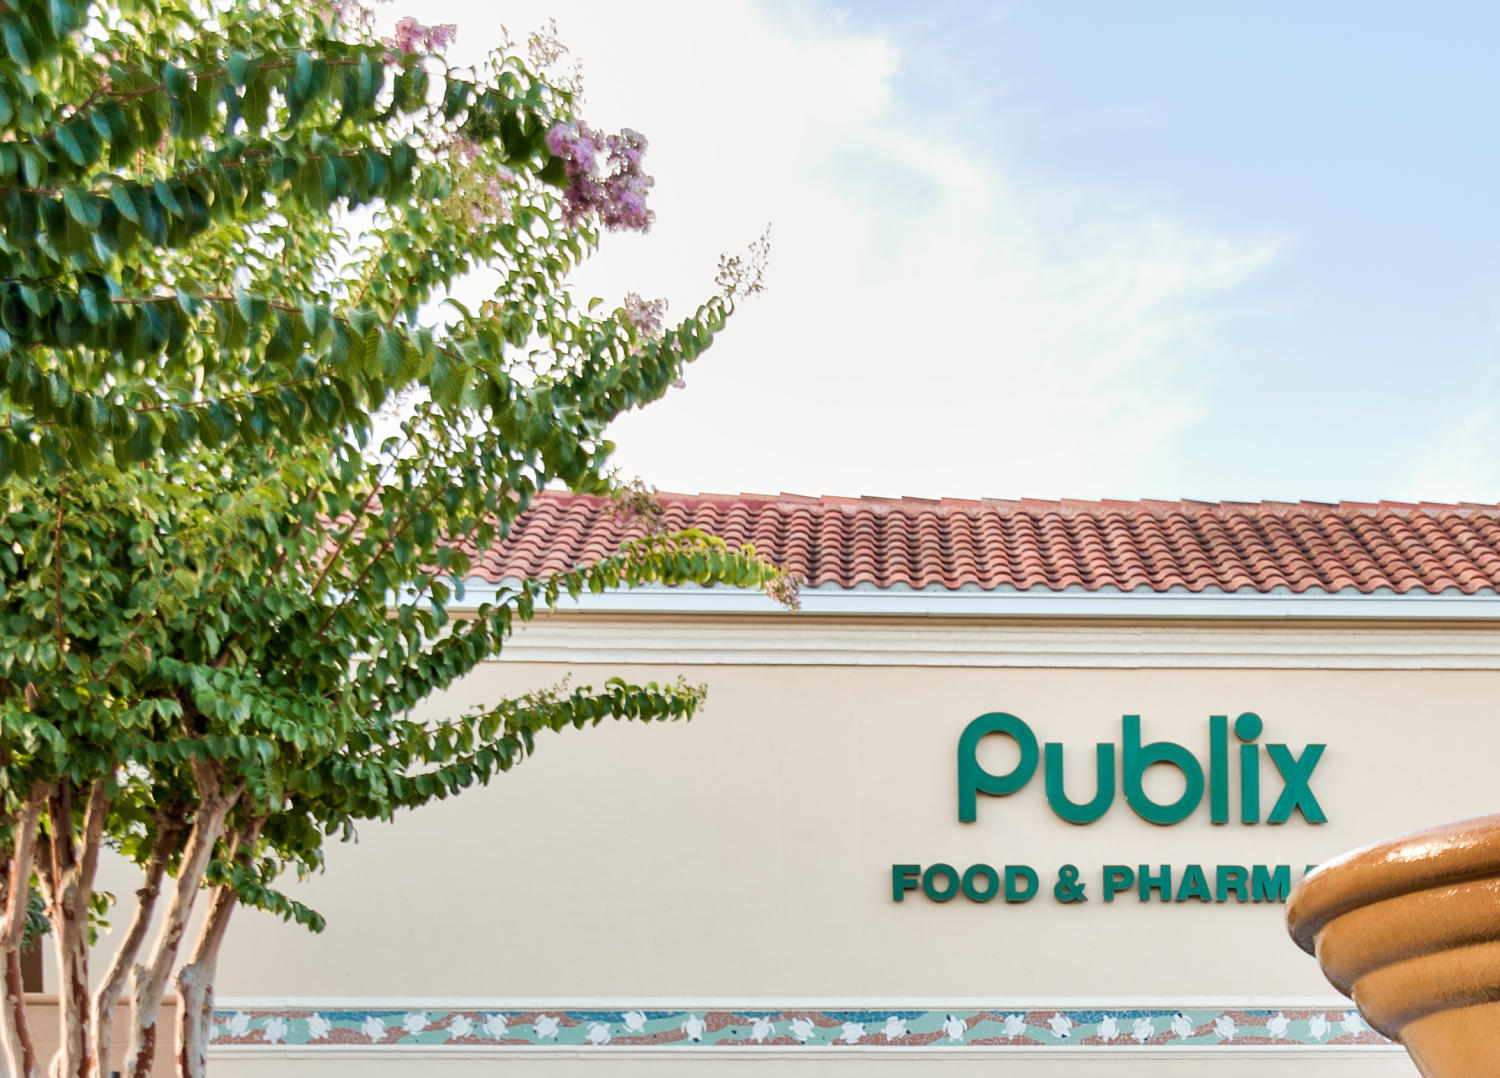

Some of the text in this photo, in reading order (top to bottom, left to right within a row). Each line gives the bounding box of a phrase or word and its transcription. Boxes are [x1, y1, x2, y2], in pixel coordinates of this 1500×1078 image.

[957, 712, 1328, 824] Publix
[892, 864, 1318, 902] FOOD & PHARM
